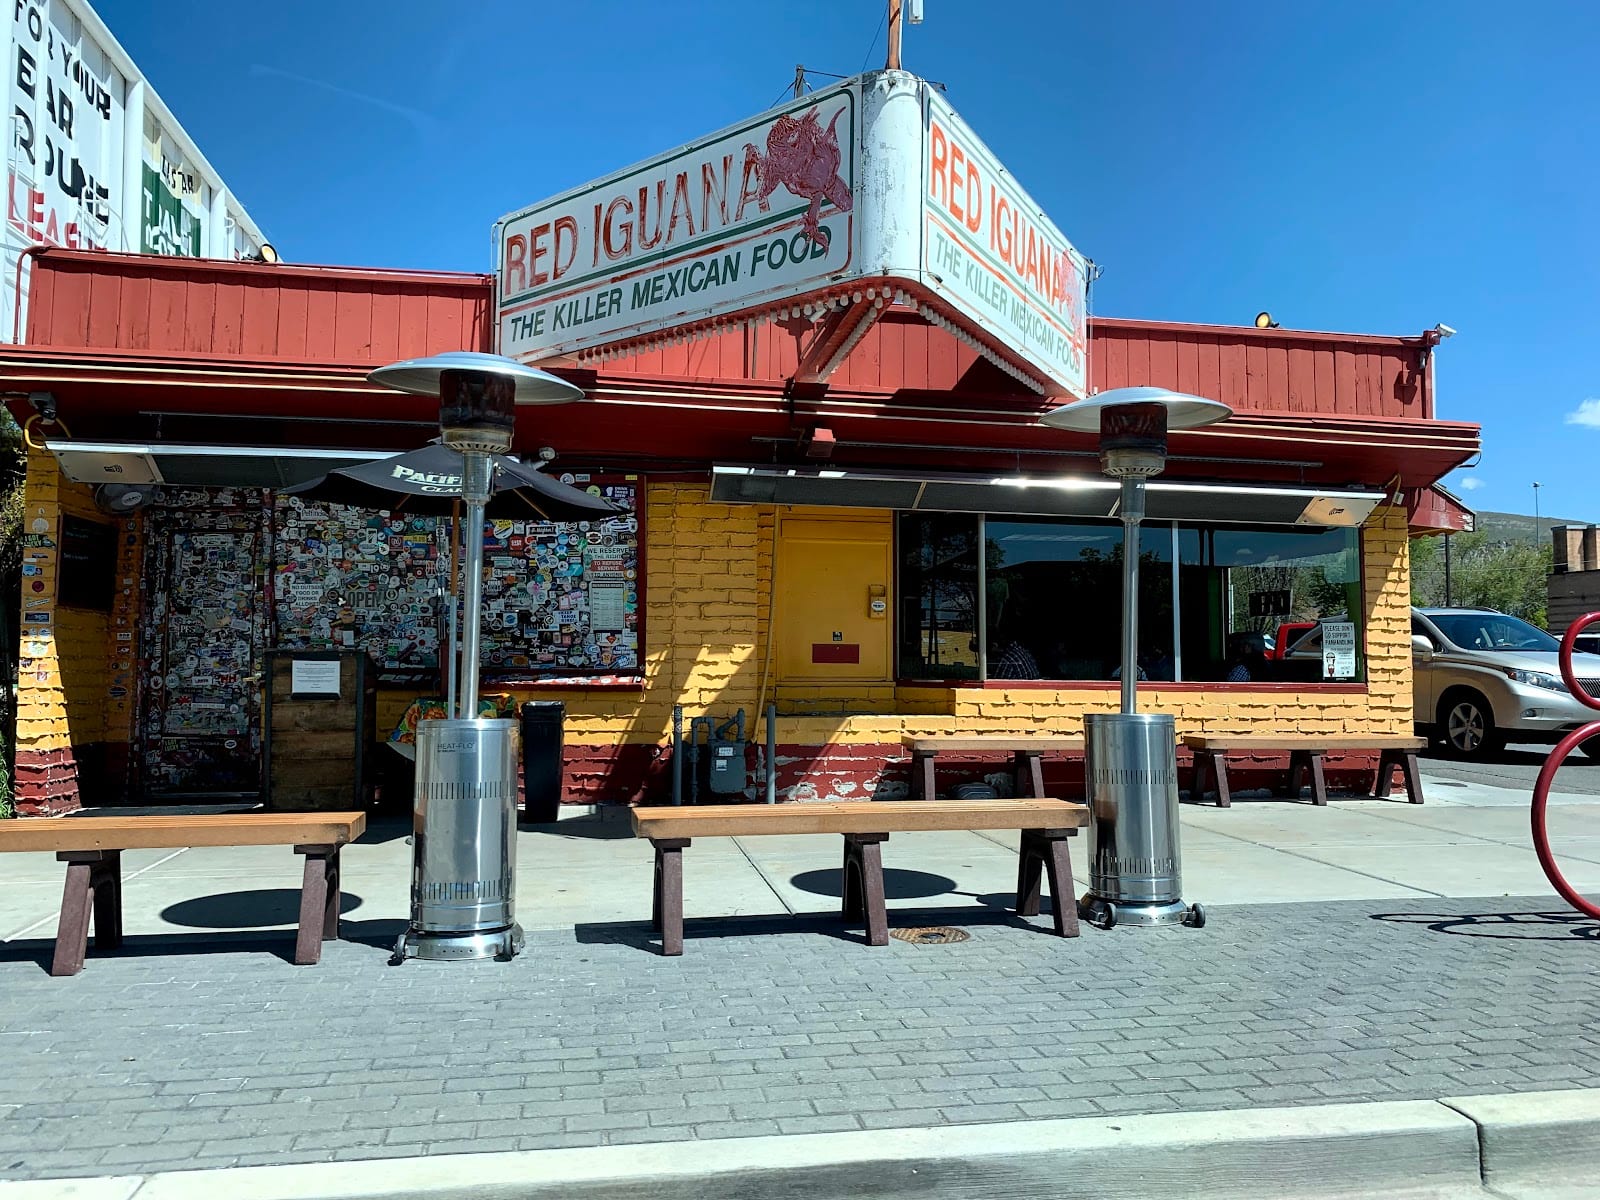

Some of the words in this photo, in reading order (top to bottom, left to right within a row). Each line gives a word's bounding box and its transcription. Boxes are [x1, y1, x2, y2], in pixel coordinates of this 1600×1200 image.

[504, 214, 578, 296] RED
[593, 150, 771, 268] IGUANA
[511, 308, 545, 342] THE
[552, 287, 623, 332] KILLER
[631, 251, 741, 311] MEXICAN
[750, 225, 833, 277] FOOD
[931, 120, 982, 234] RED
[989, 183, 1064, 316] IGUANA
[935, 232, 960, 281] THE
[965, 256, 1008, 315] KILLER
[1011, 301, 1055, 353] MEXICAN
[1056, 336, 1081, 375] FOOD
[348, 592, 380, 607] OPEN
